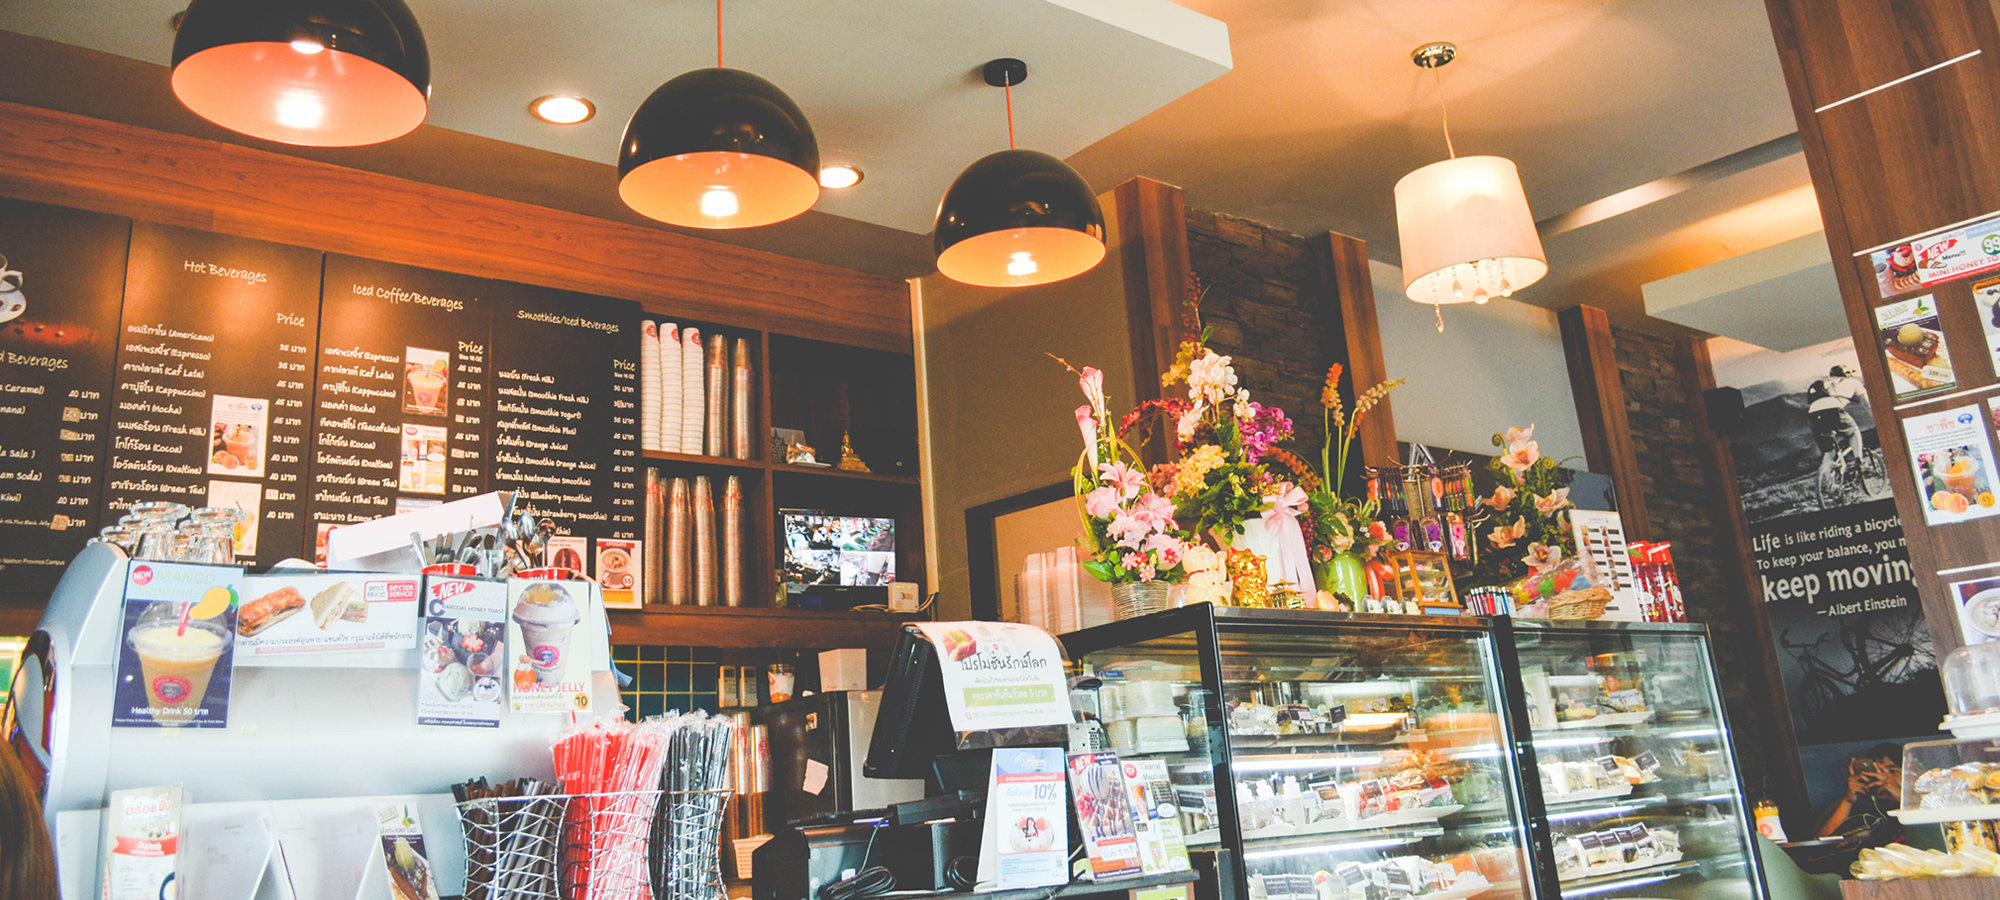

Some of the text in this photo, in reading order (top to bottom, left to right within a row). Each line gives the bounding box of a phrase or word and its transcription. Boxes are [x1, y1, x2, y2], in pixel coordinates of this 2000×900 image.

[1927, 240, 1949, 260] NEW
[1983, 236, 2000, 253] 99
[184, 260, 268, 285] Hot Beverages
[1929, 260, 1984, 279] MINI HONEY
[353, 284, 464, 312] Iced Coffee/Beverages
[276, 312, 305, 327] Price
[517, 310, 619, 334] Smoothies/Iced Beverages
[168, 329, 215, 342] (Americano)
[279, 344, 306, 353] 35 บาท
[458, 341, 484, 354] Price
[170, 348, 211, 361] (Espresso)
[363, 352, 400, 364] (Espresso)
[7, 352, 68, 372] Beverages
[278, 362, 305, 372] 35 บาท
[613, 359, 635, 372] Price
[183, 369, 204, 379] Late)
[375, 371, 395, 381] Late)
[521, 373, 555, 384] (Fresh Milk)
[5, 384, 45, 395] Caramel)
[155, 385, 206, 398] (Cappuccino)
[276, 380, 304, 390] 45 บาท
[467, 382, 481, 390] บาท
[68, 390, 100, 399] 40 บาท
[352, 387, 397, 398] (Cappuccino)
[528, 390, 590, 404] (Smoothie Fresh Milk)
[119, 400, 183, 415] มอคค่า (Mocha)
[275, 398, 302, 408] 45 บาท
[321, 400, 376, 414] มอคค่า (Mocha)
[530, 407, 559, 417] (Smoothie
[273, 417, 301, 426] 45 บาท
[117, 420, 207, 437] นมสดร้อน (Fresh Milk)
[532, 424, 577, 435] (Smoothie Plus)
[284, 436, 299, 445] บาท
[318, 432, 376, 450] โกโก้เย็น (Cocoa)
[465, 434, 479, 442] บาท
[115, 436, 183, 454] โกโก้ร้อน (Cocoa)
[526, 441, 568, 451] (Orange Juice)
[112, 456, 203, 475] โอวัลตินร้อน (Ovaltine)
[282, 455, 298, 463] บาท
[317, 451, 393, 470] โอวัลตินเย็น (Ovaltine)
[525, 456, 597, 470] (Smoothie Orange Juice)
[16, 470, 42, 482] Soda)
[269, 473, 296, 482] 40 บาท
[464, 468, 478, 476] บาท
[316, 472, 398, 488] ชาเขียวเย็น (Green Tea)
[524, 473, 591, 486] (Watermelon Smoothie)
[110, 480, 206, 495] ชาเขียวร้อน (Green Tea)
[57, 496, 88, 505] 40 บาท
[280, 492, 295, 501] บาท
[314, 489, 388, 505] ชาไทยเย็น (Thai Tea)
[530, 490, 562, 504] (Blueberry
[562, 493, 593, 502] Smoothie)
[266, 511, 294, 520] 40 บาท
[541, 509, 577, 522] (Strawberry
[578, 511, 608, 520] Smoothie)
[1752, 533, 1781, 553] Life
[1784, 534, 1794, 546] is
[1796, 531, 1816, 543] like
[1818, 525, 1852, 540] riding
[1854, 524, 1862, 533] a
[1756, 559, 1770, 570] To
[1772, 555, 1797, 568] keep
[1799, 550, 1824, 566] your
[1827, 542, 1872, 559] balance,
[1874, 540, 1896, 554] you
[133, 571, 152, 580] NEW
[157, 569, 216, 583] MANGO
[439, 582, 467, 600] NEW
[1761, 573, 1820, 604] keep
[429, 599, 467, 616] CHARCOAL
[1828, 595, 1907, 617] Albert Einstein
[961, 651, 1047, 671] โปรโมชั่นรักษ์โลก
[513, 682, 585, 693] HONEY JELLY
[1029, 689, 1034, 697] 3
[1035, 688, 1047, 697] บาท
[576, 696, 587, 707] 10
[131, 706, 161, 716] Healthy
[1075, 755, 1091, 775] NEW
[1034, 783, 1057, 800] 10%
